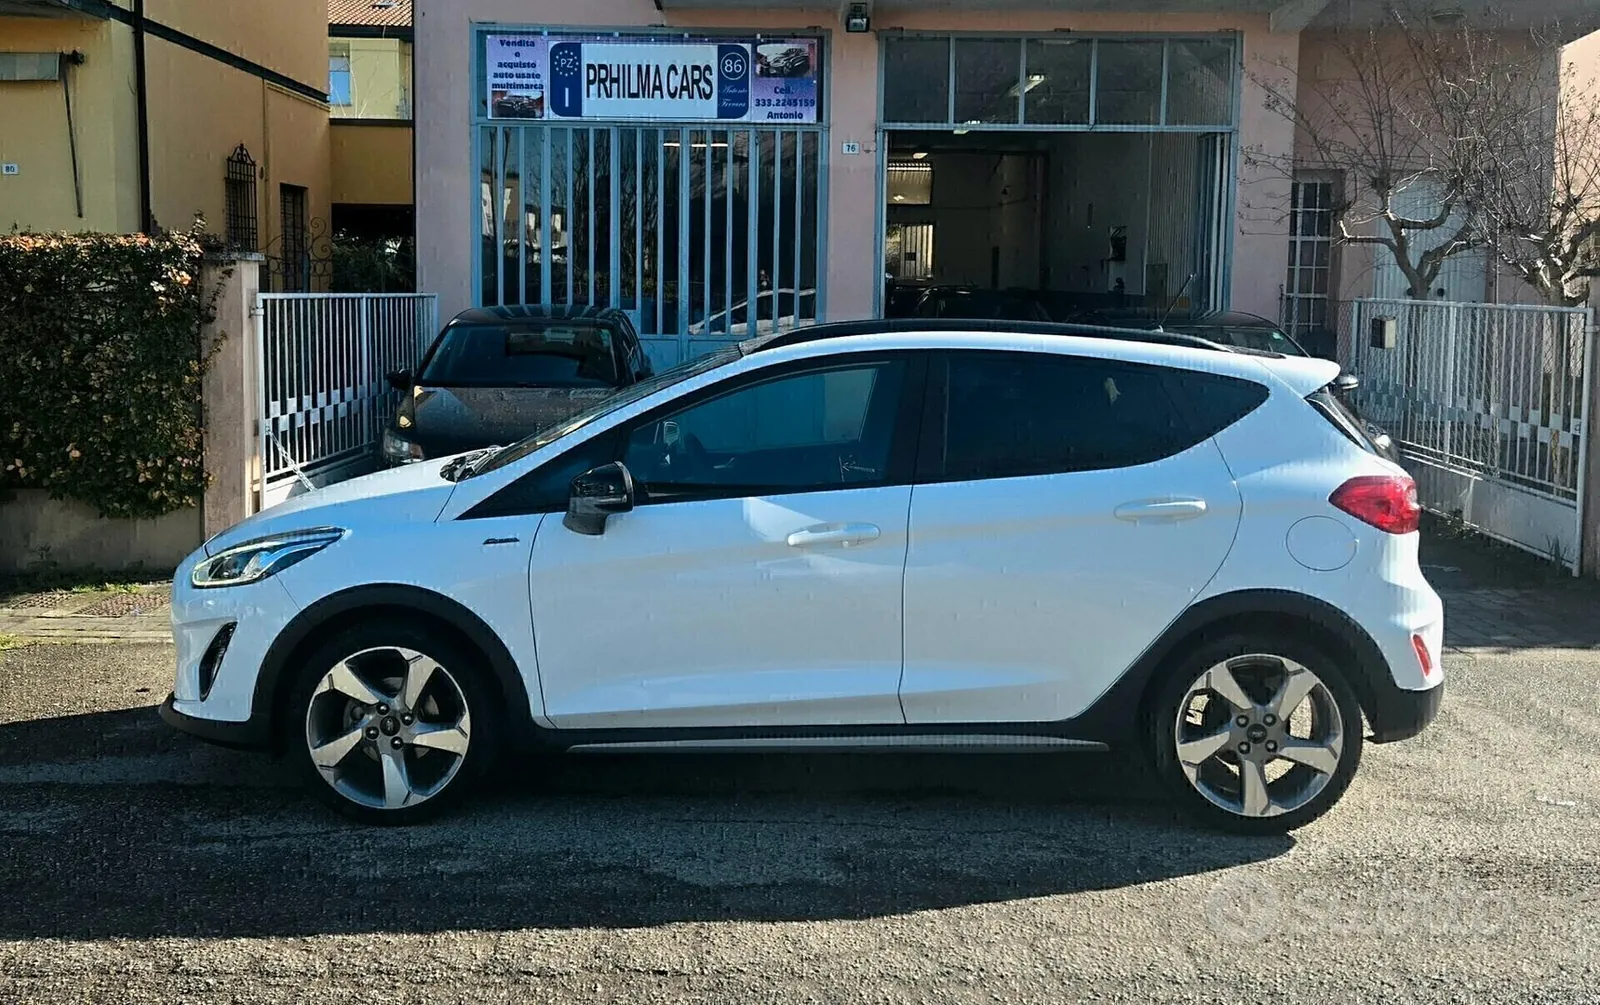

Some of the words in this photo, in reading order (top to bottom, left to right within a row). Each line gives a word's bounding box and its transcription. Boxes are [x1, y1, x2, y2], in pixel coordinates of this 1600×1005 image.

[500, 39, 535, 47] Vendita
[497, 61, 536, 69] acquisto
[560, 58, 574, 69] PZ
[724, 59, 743, 73] 86
[491, 82, 543, 90] multimarca
[586, 63, 664, 99] PRHILMA
[666, 63, 713, 101] CARS
[774, 86, 794, 95] Cell.
[767, 111, 804, 119] Antonio
[846, 144, 856, 153] 76
[5, 165, 15, 173] 80
